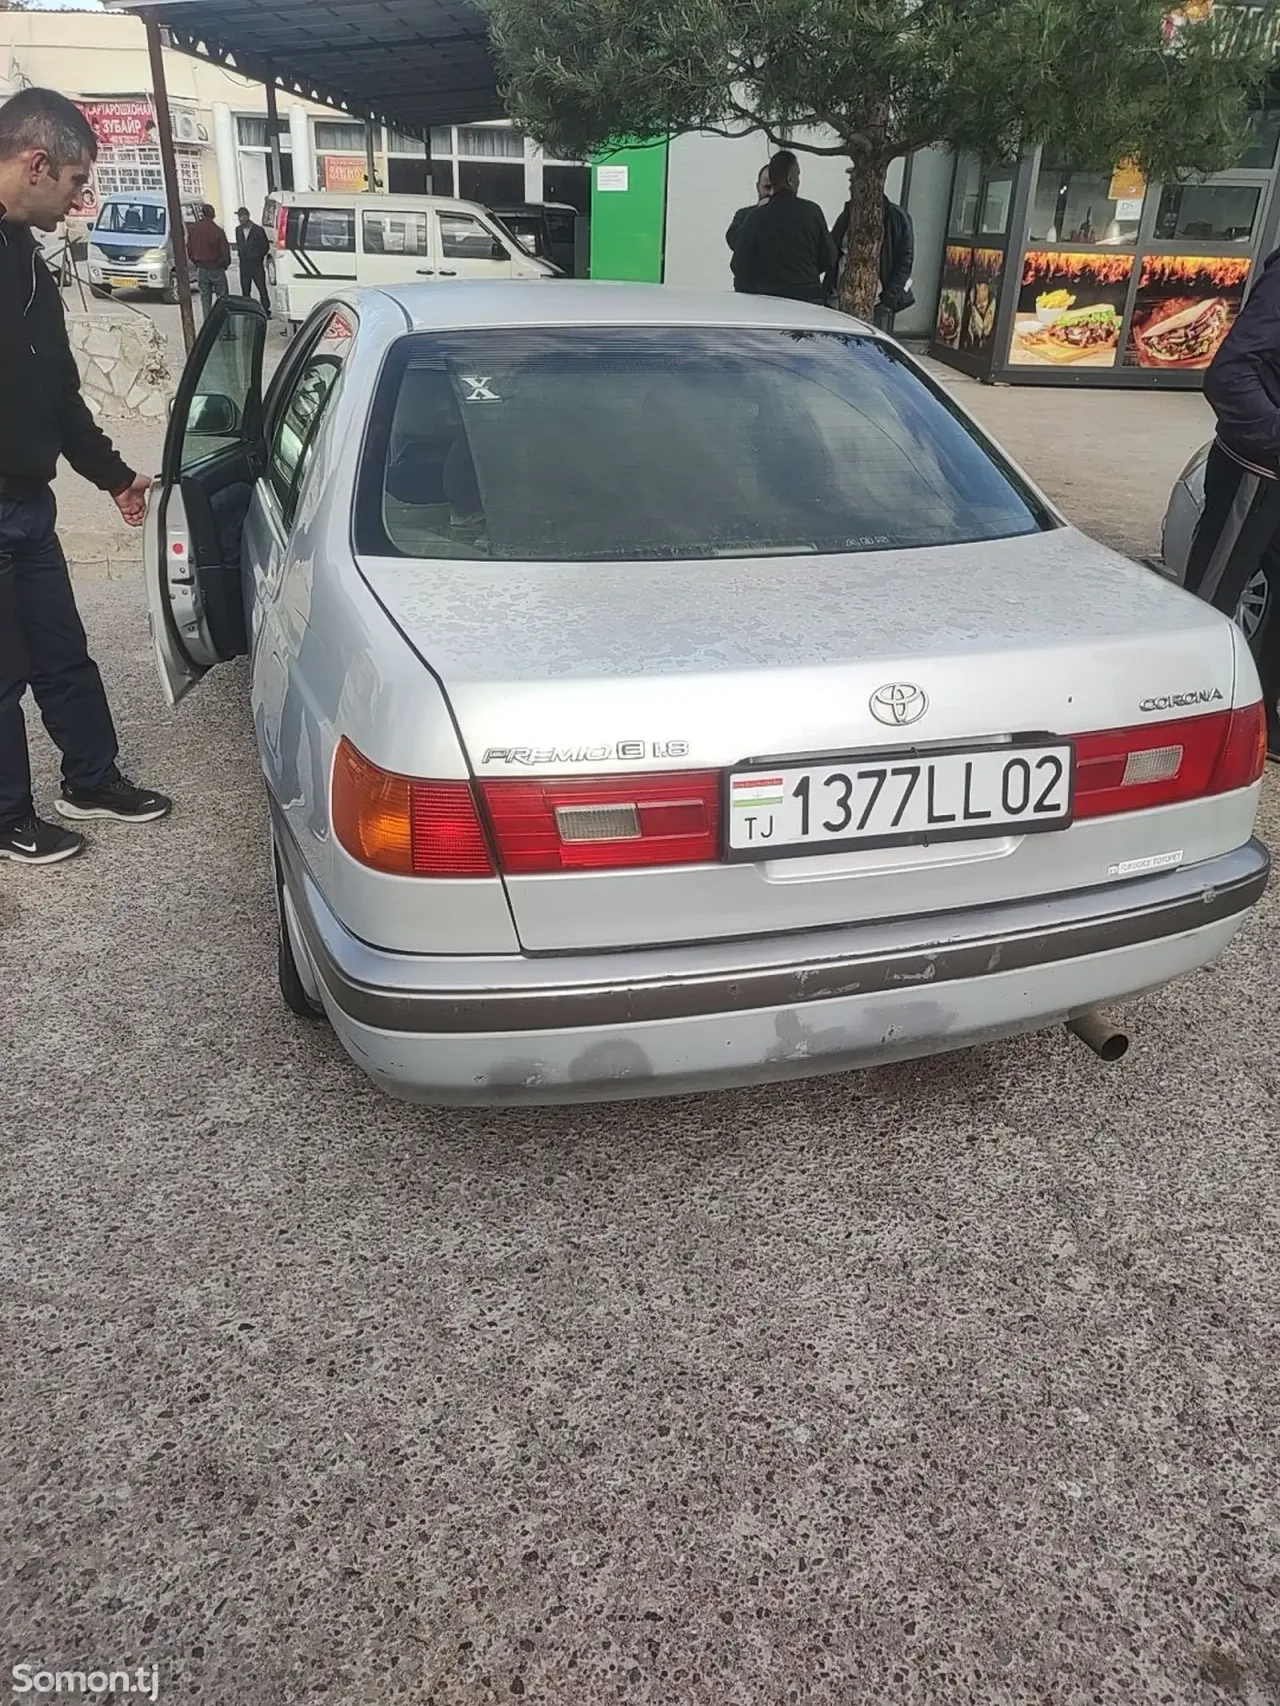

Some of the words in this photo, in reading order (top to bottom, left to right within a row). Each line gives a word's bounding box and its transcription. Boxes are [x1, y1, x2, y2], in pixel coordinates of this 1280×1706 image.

[102, 117, 142, 134] ЗУБАЙР
[1139, 688, 1223, 712] CORONA
[481, 746, 612, 765] PREMIO
[744, 815, 774, 840] TJ
